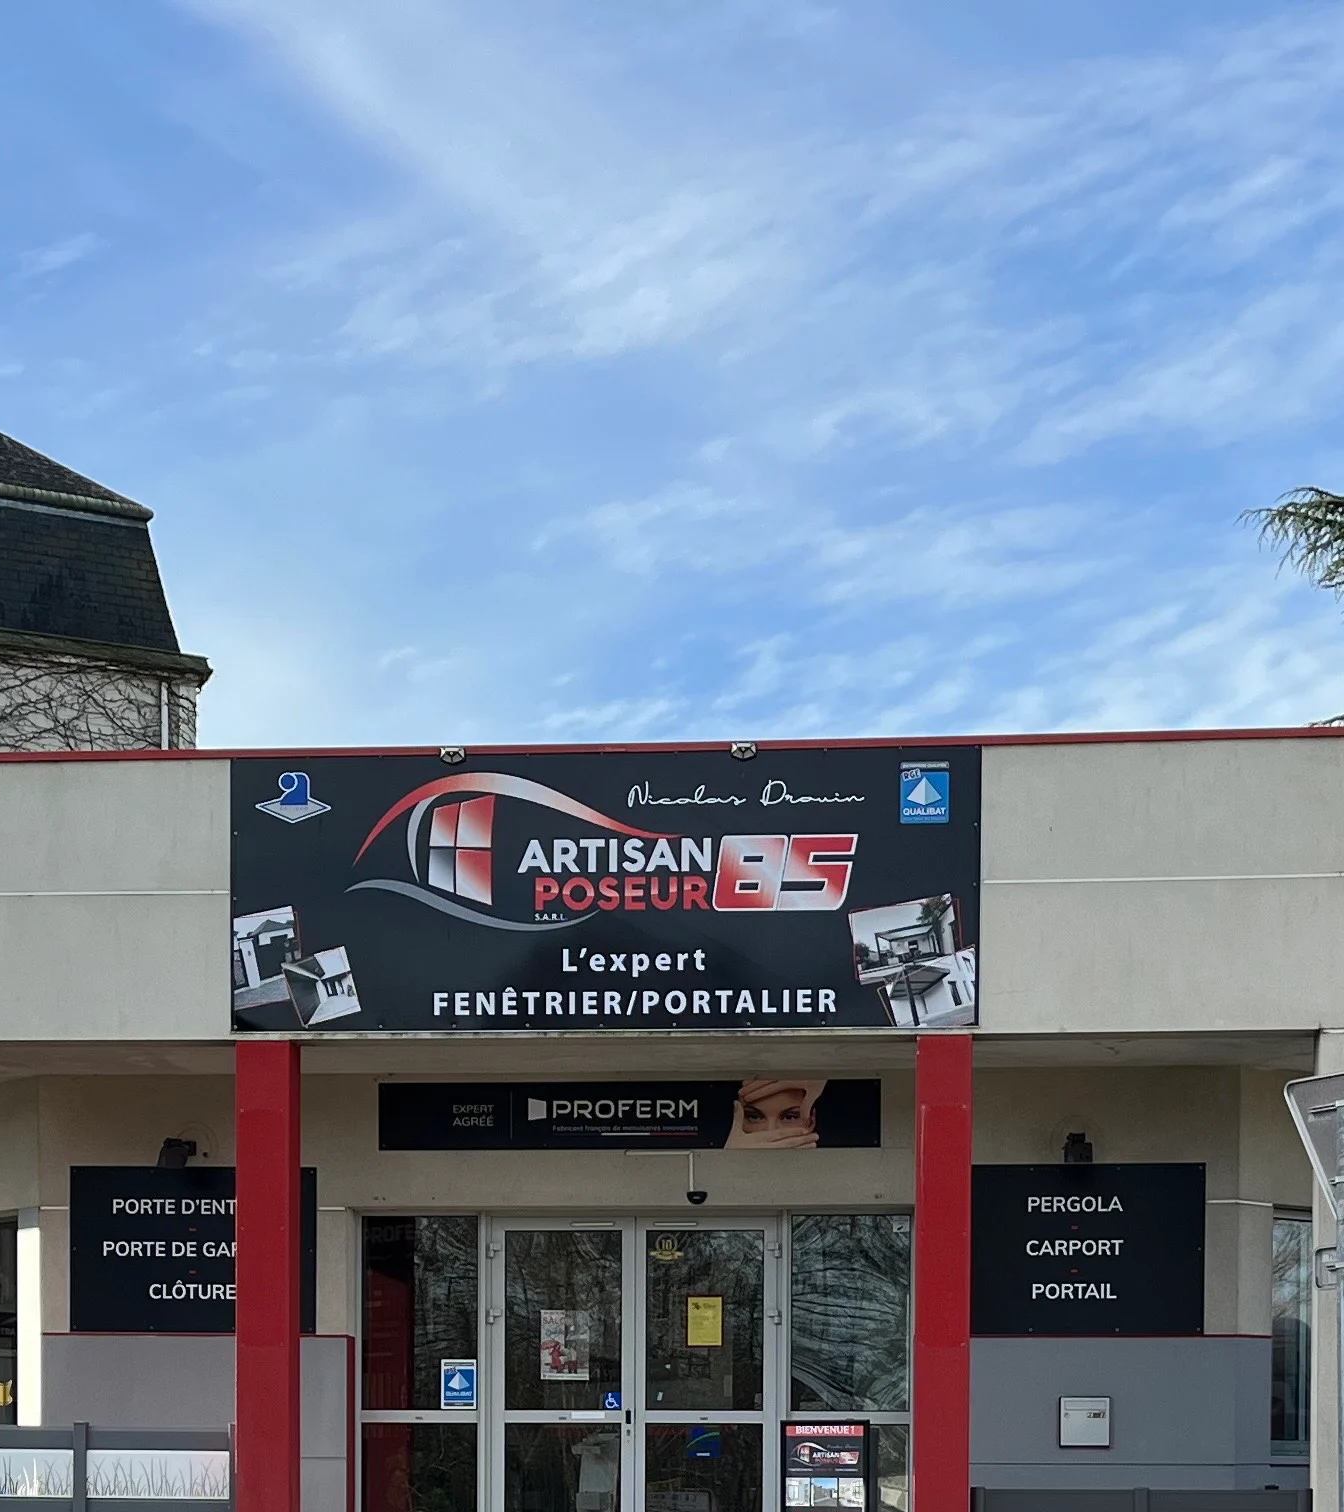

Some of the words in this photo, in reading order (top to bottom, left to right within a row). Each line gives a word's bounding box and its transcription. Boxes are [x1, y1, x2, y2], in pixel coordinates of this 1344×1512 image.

[627, 781, 746, 807] Nicolas
[903, 807, 946, 816] QUALIBAT
[517, 837, 712, 873] ARTISAN
[712, 834, 858, 911] 85
[535, 877, 710, 911] POSEUR
[562, 948, 706, 977] L'expert
[433, 987, 837, 1016] FENÊTRIER/PORTALIER
[453, 1104, 494, 1113] EXPERT
[553, 1100, 698, 1118] PROFERM
[453, 1115, 494, 1126] AGRÉÉ
[112, 1199, 176, 1214] PORTE
[181, 1199, 237, 1214] D'ENT
[1027, 1196, 1123, 1212] PERGOLA
[103, 1241, 166, 1256] PORTE
[172, 1242, 197, 1256] DE
[1026, 1240, 1124, 1256] CARPORT
[149, 1280, 236, 1300] CLÔTURE
[1032, 1283, 1117, 1299] PORTAIL
